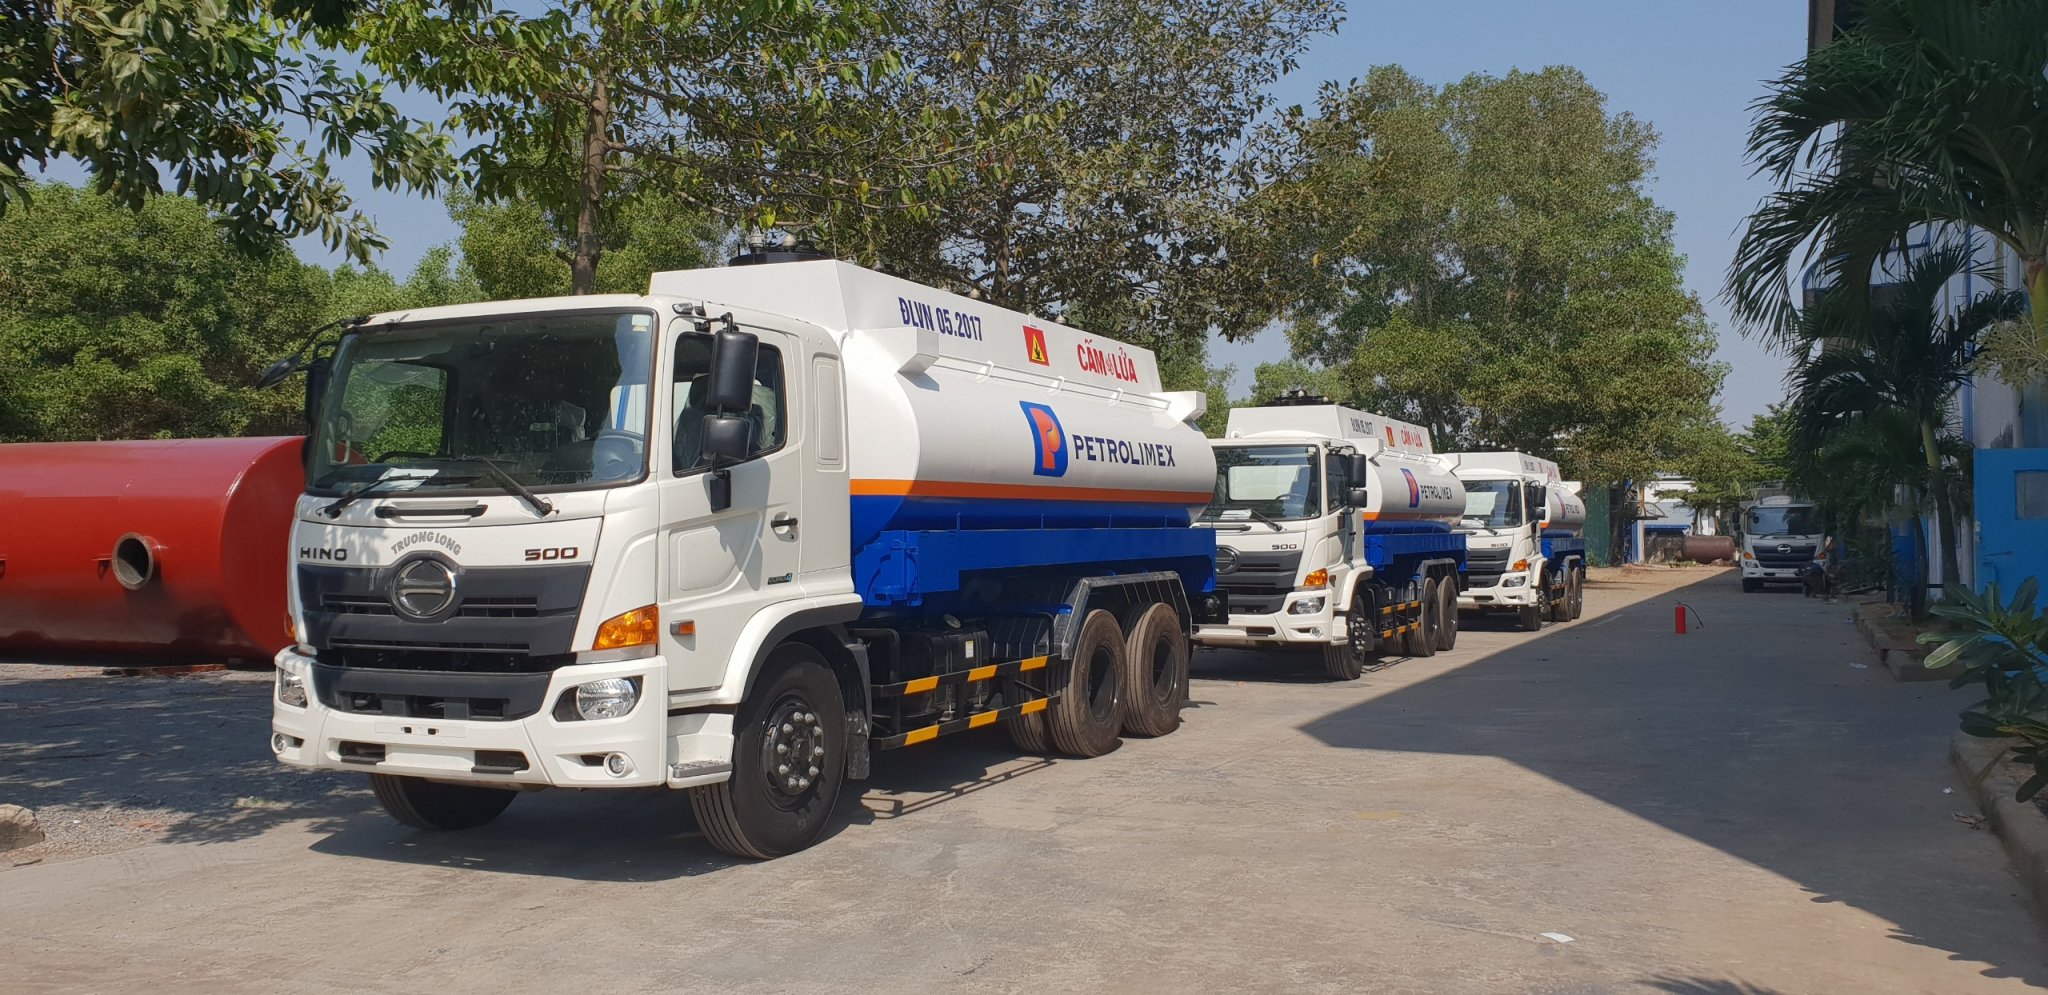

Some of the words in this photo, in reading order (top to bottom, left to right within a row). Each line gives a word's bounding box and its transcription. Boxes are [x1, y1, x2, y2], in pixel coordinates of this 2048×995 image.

[898, 296, 935, 331] ĐLVN
[936, 307, 983, 341] 05.2017
[1077, 338, 1107, 376] CẤM
[1112, 346, 1138, 383] LỬA
[1071, 434, 1176, 467] PETROLIMEX
[300, 546, 347, 561] HINO
[391, 531, 434, 555] TRUONG
[434, 532, 462, 556] LONG
[525, 546, 578, 561] 500
